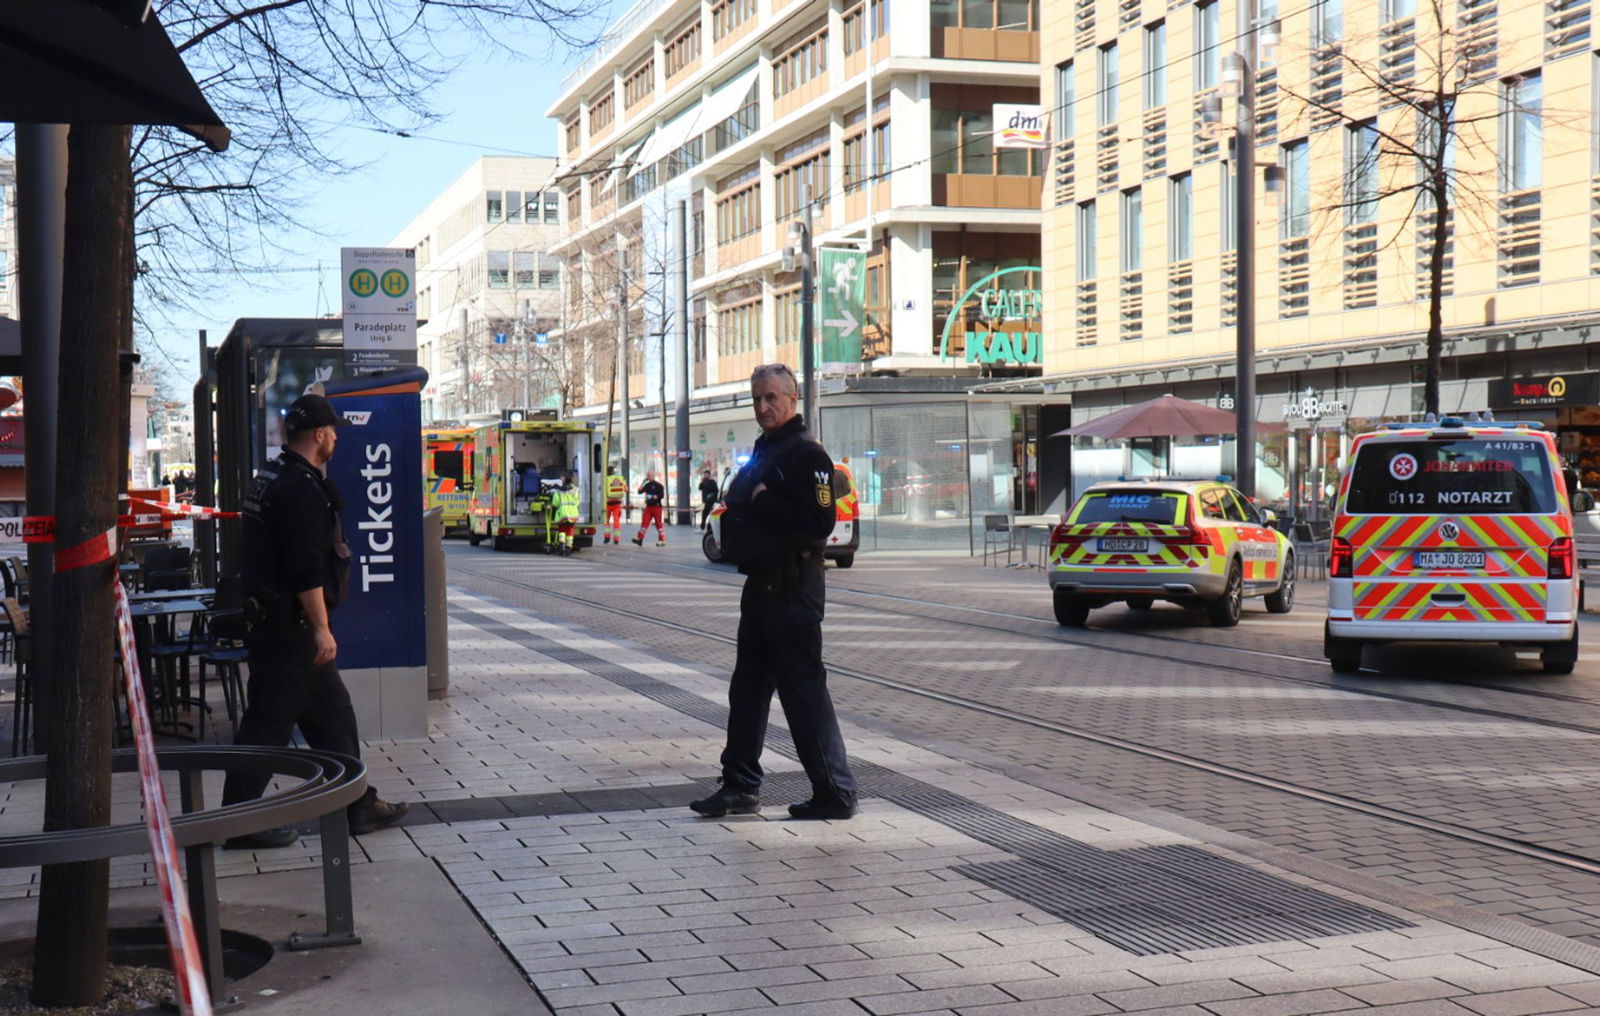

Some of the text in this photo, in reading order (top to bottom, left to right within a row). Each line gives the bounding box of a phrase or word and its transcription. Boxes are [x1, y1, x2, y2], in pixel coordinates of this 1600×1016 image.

[1009, 110, 1038, 129] dm
[358, 276, 401, 290] H H
[354, 322, 406, 334] Paradeplatz
[352, 353, 358, 362] 2
[353, 367, 359, 377] 3
[346, 414, 365, 422] rnv
[1424, 460, 1513, 473] JOHANNITER
[1110, 494, 1152, 504] MIC
[1398, 491, 1513, 504] 112 NOTARZT
[358, 442, 395, 592] Tickets
[1420, 553, 1434, 564] MA
[1457, 553, 1483, 565] 8201
